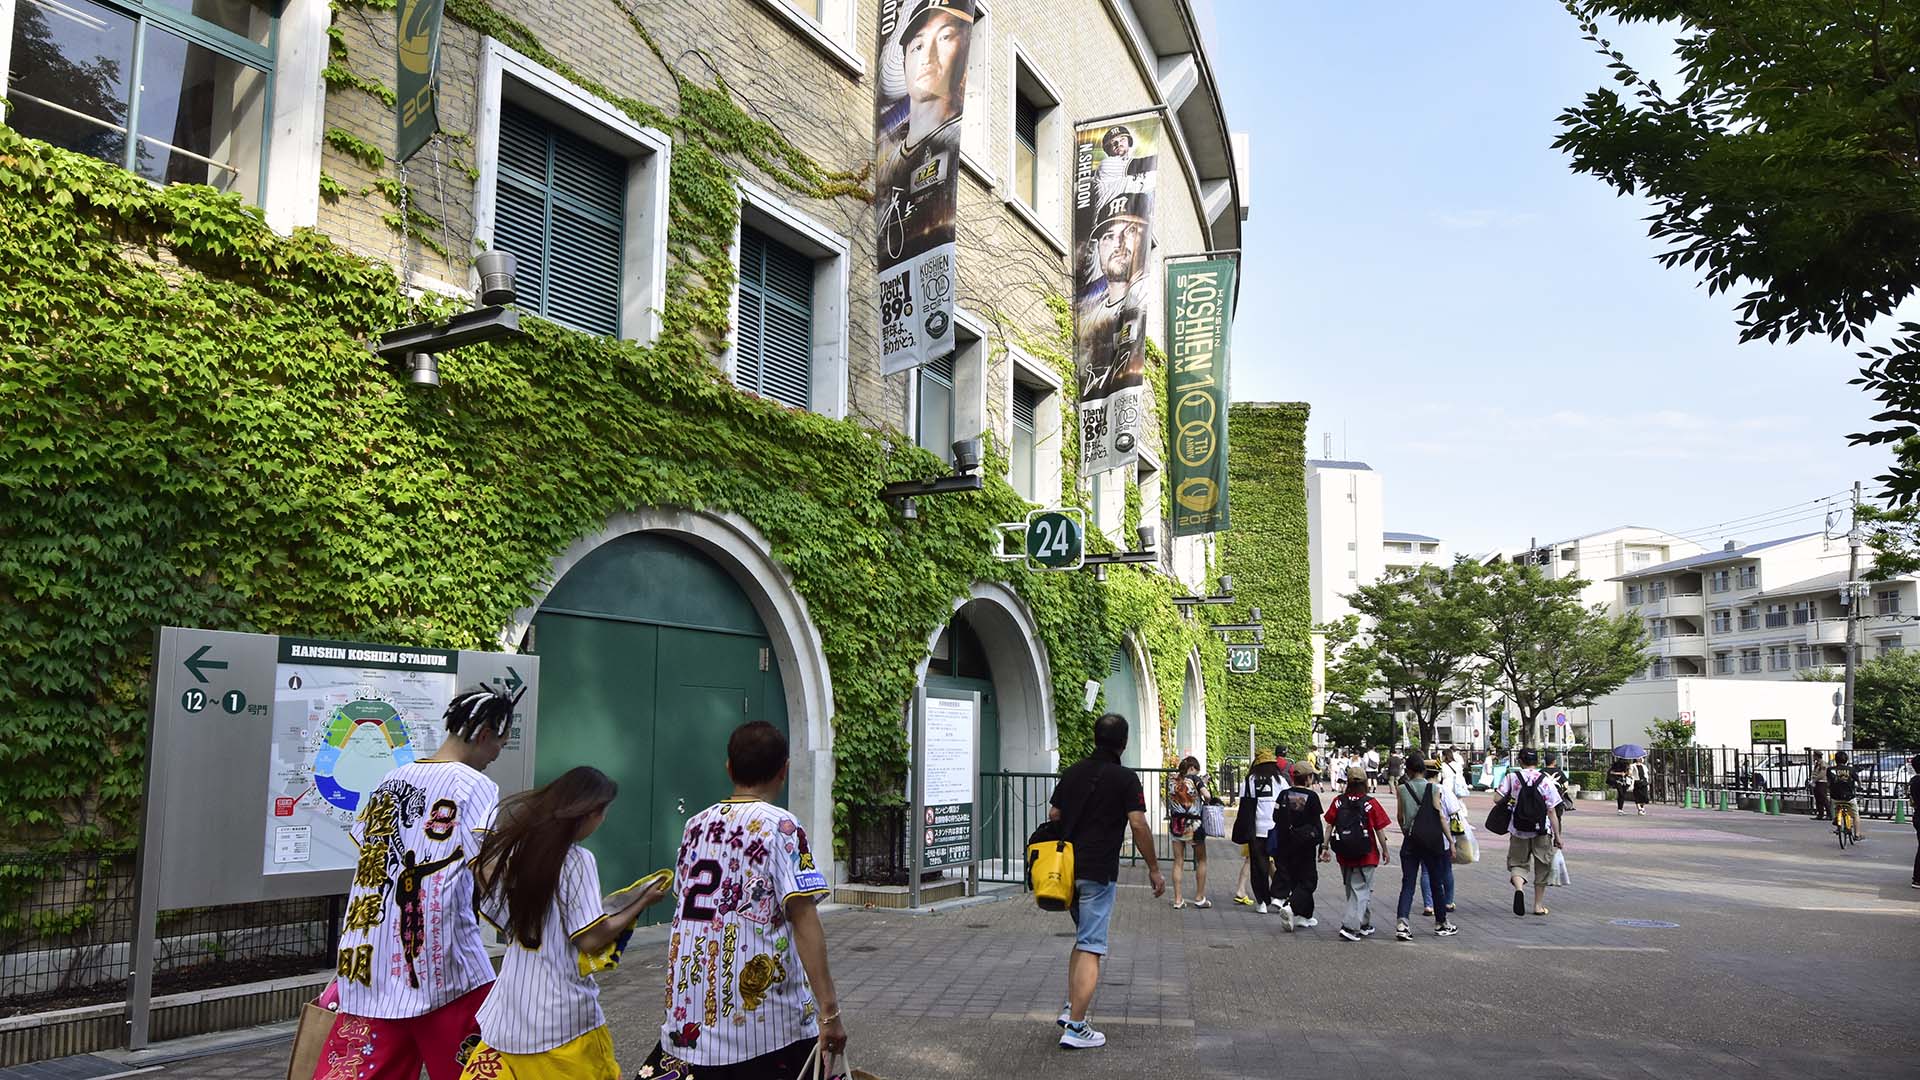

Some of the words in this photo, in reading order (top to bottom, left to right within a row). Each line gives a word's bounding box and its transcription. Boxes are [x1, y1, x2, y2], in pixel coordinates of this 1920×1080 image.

[881, 0, 897, 35] OTO
[1077, 142, 1093, 209] N.SHELDON
[880, 274, 902, 294] Thank
[920, 254, 949, 278] KOSHIEN
[1174, 274, 1187, 374] STADIUM
[1184, 271, 1218, 372] KOSHIEN
[1214, 288, 1224, 347] HANSHIN
[1036, 518, 1069, 559] 24
[291, 644, 346, 660] HANSHIN
[348, 649, 398, 663] KOSHIEN
[399, 653, 447, 666] STADIUM
[1236, 649, 1252, 668] 23
[186, 692, 203, 711] 12
[424, 798, 458, 842] 8
[337, 789, 397, 988] 佐藤輝明
[404, 878, 414, 892] 8
[682, 858, 724, 922] 2
